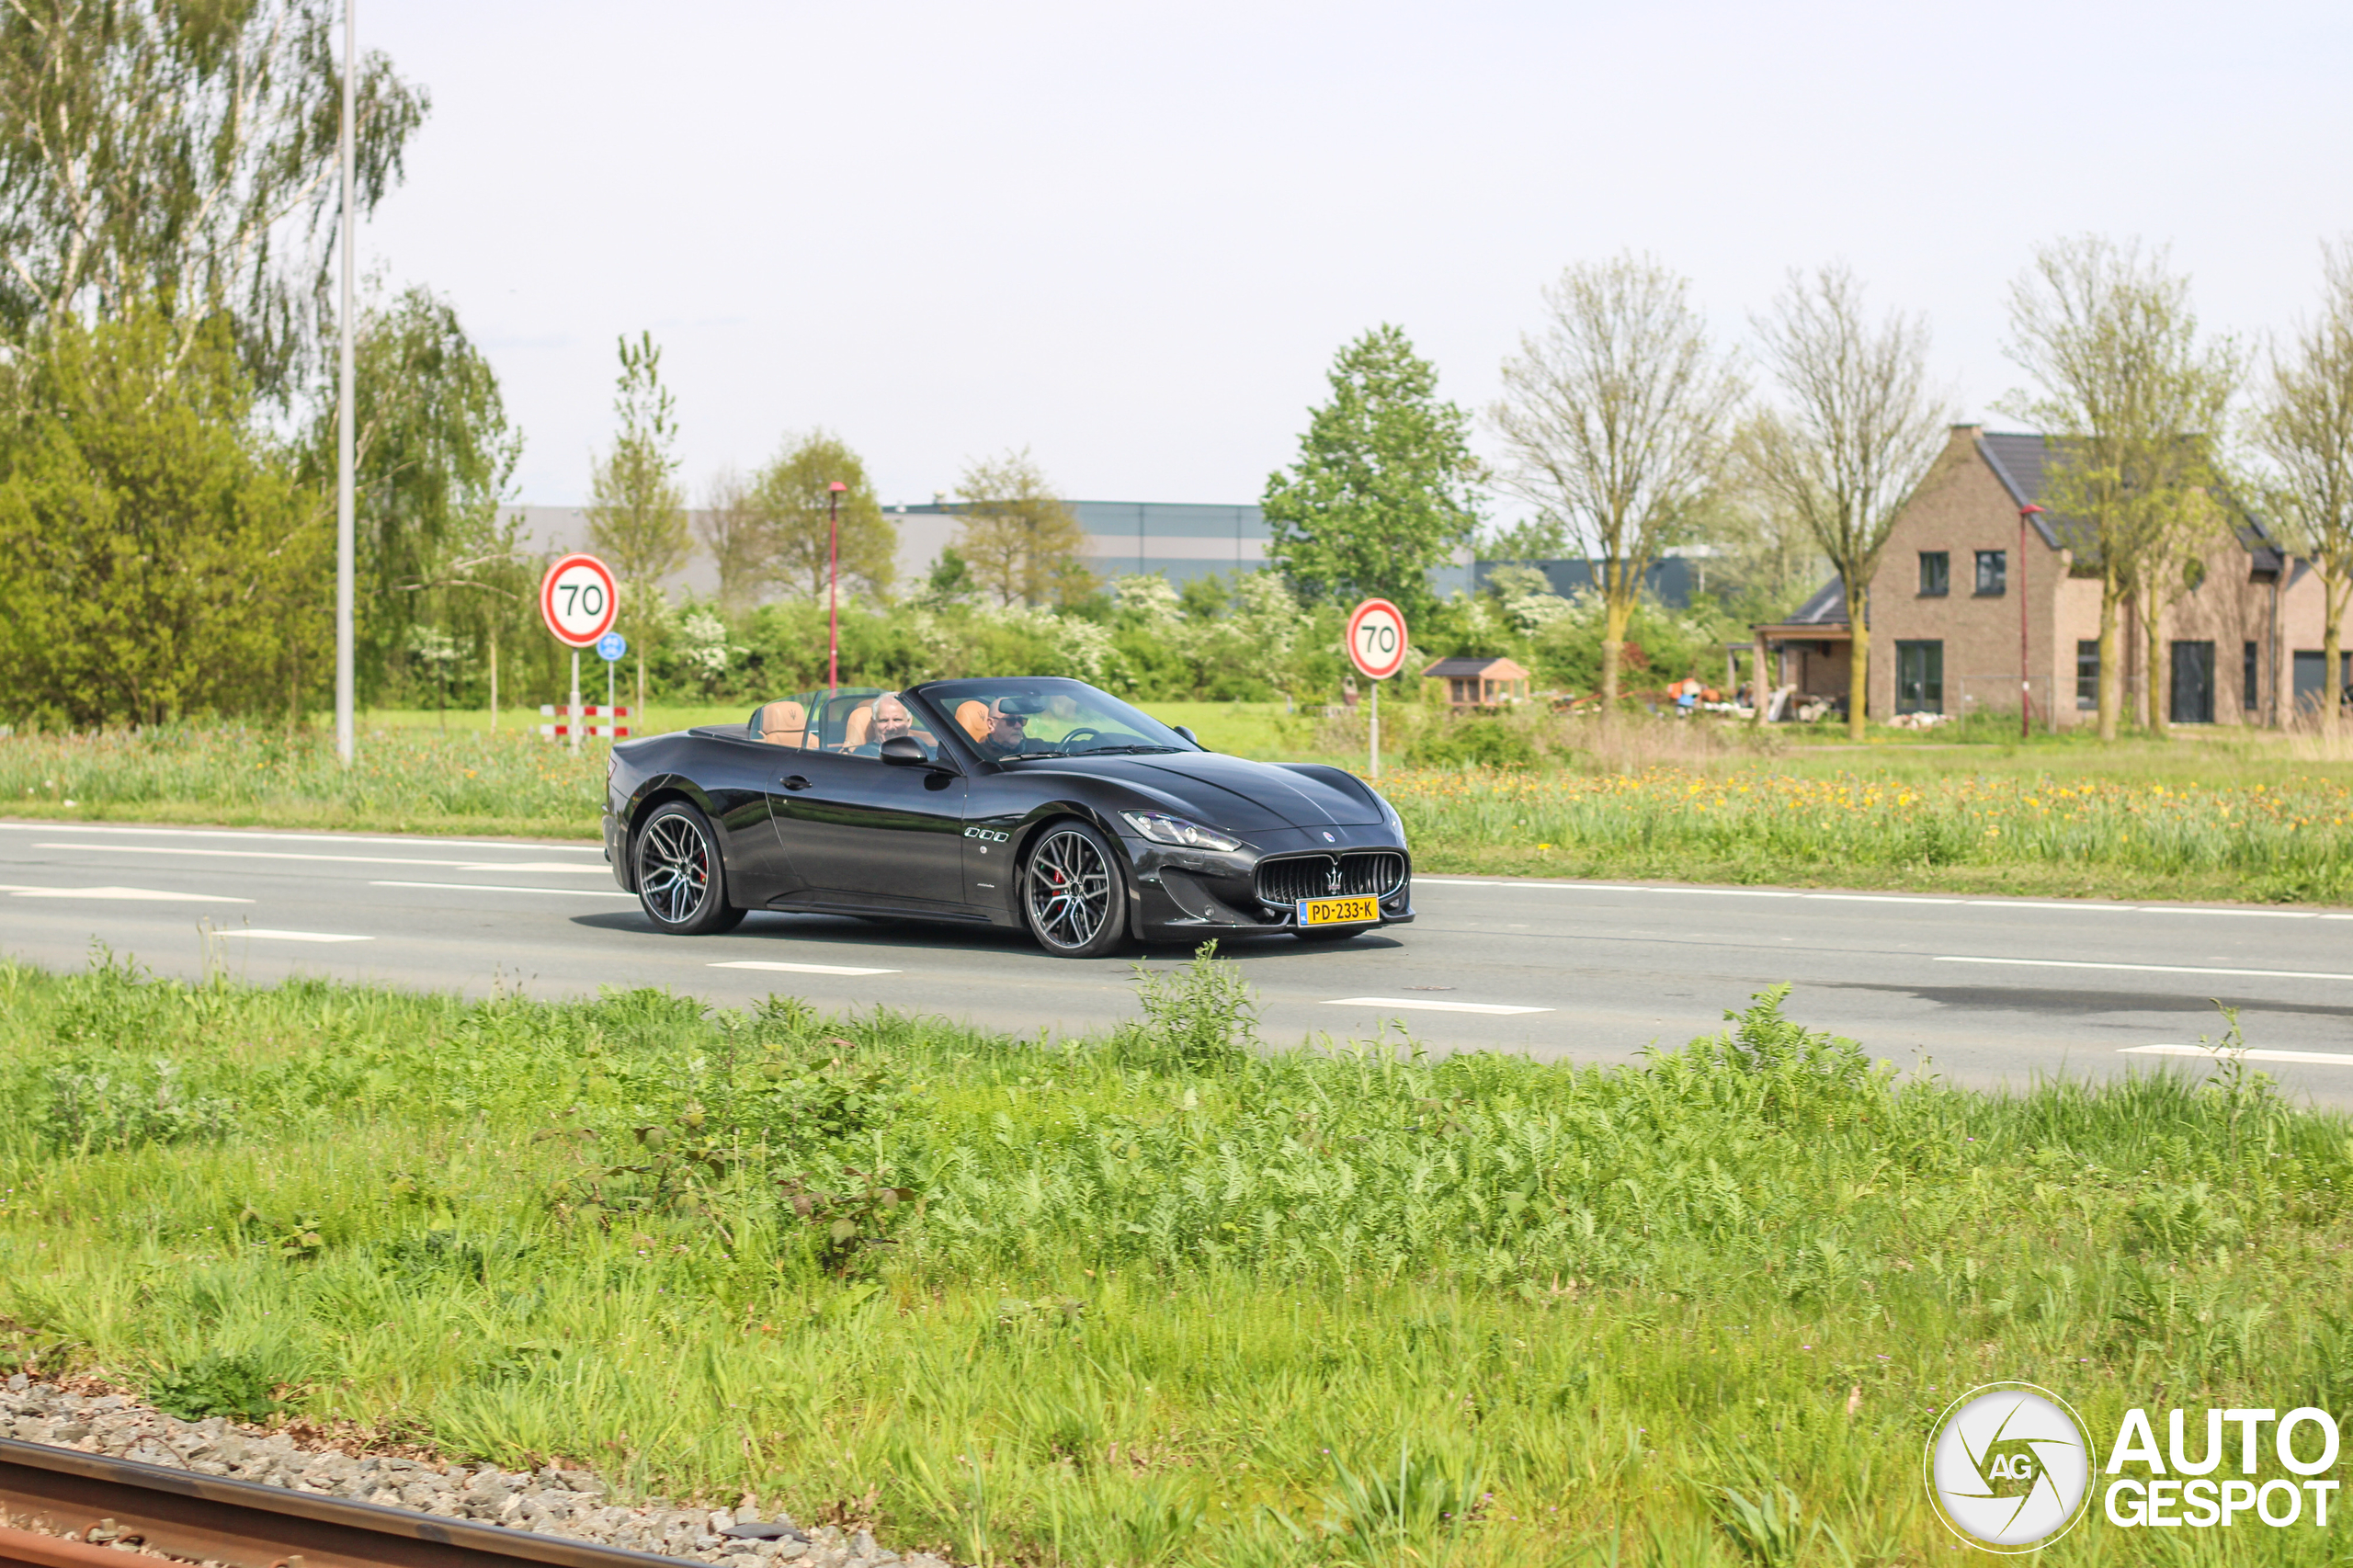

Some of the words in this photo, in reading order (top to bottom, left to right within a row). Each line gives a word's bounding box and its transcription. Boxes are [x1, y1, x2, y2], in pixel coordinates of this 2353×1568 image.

[559, 584, 603, 616] 70
[1361, 625, 1395, 653] 70
[1313, 901, 1372, 921] PD-233-K
